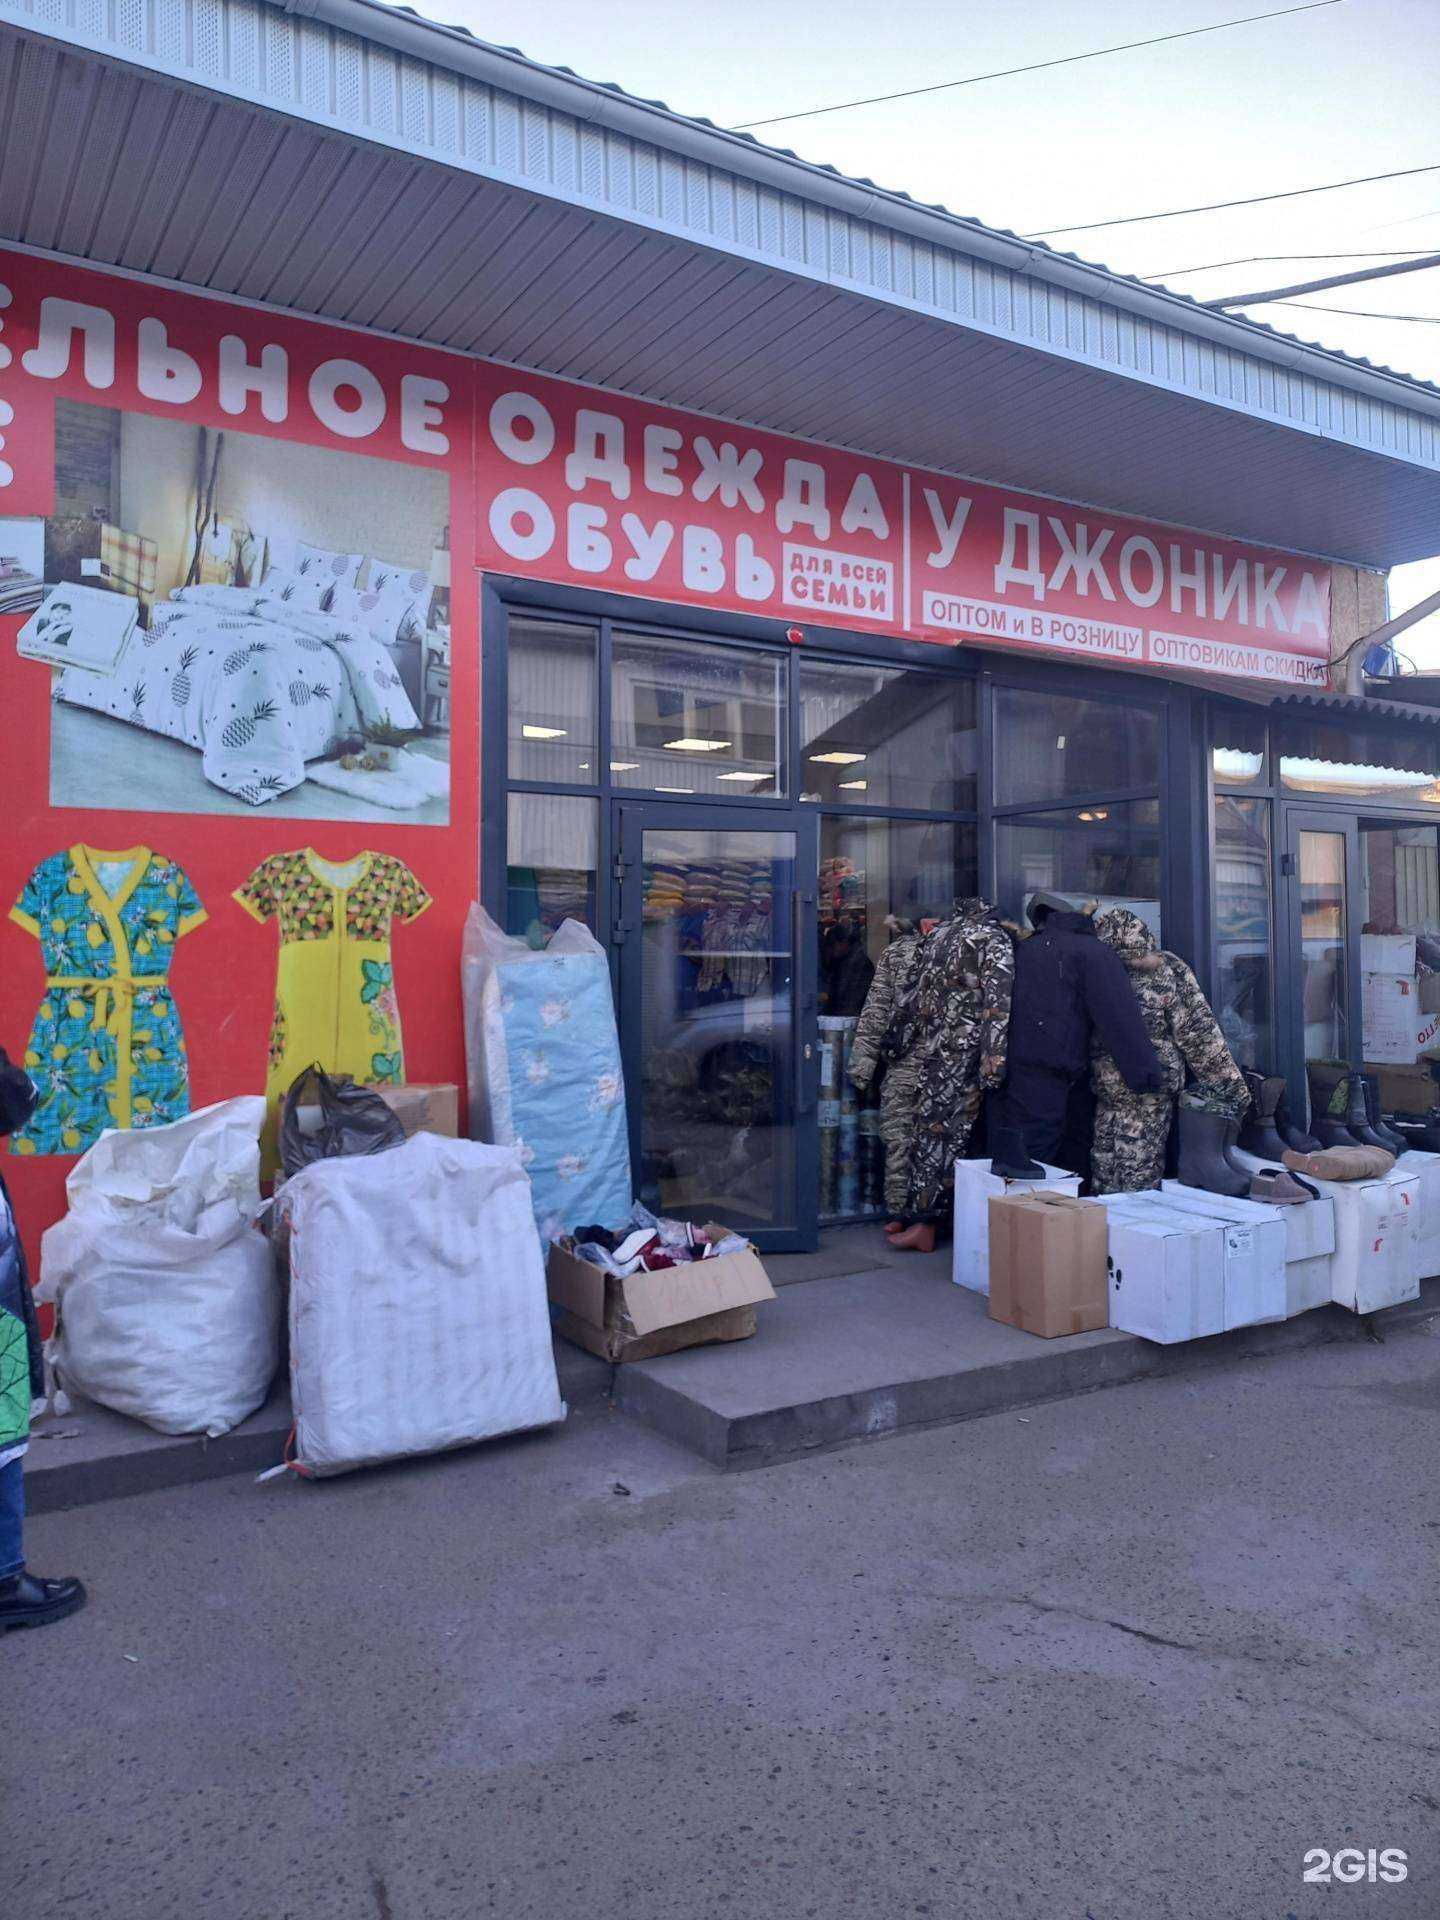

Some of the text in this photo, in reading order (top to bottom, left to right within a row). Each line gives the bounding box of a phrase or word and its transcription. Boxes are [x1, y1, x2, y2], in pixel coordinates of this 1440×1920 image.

[0, 283, 450, 456] ЛЬНОЕ
[488, 391, 890, 541] ОДЕЖДА
[488, 487, 775, 601] ОБУВЬ
[790, 552, 887, 586] ДЛЯ ВСЕЙ
[922, 487, 1327, 639] У ДЖОНИКА
[790, 575, 887, 613] СЕМЬИ
[931, 599, 1006, 632] ОПТОМ
[1031, 616, 1044, 637] В
[1050, 619, 1140, 656] РОЗНИЦУ
[1153, 637, 1260, 673] ОПТОВИКАМ
